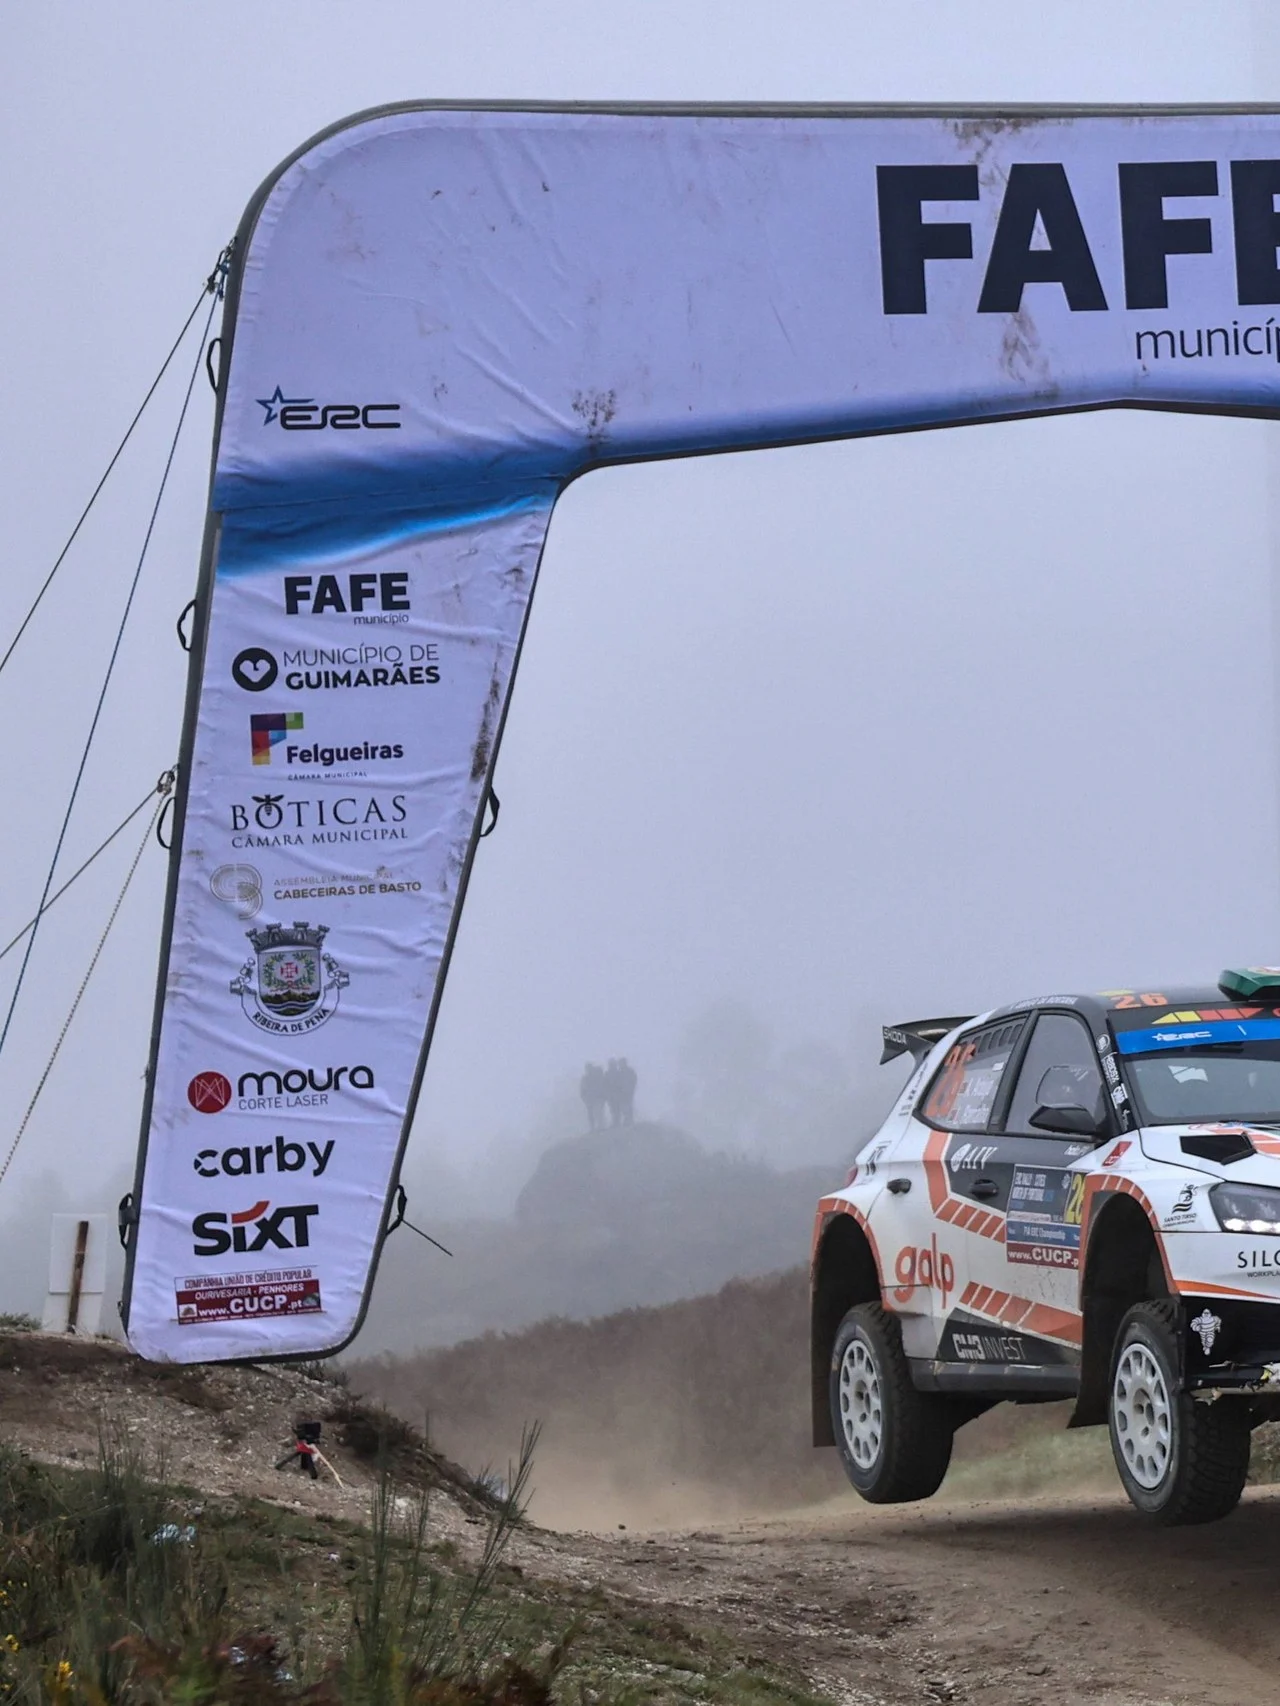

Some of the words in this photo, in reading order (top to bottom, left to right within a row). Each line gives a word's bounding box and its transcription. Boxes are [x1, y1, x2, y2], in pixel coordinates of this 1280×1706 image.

[280, 404, 401, 430] ERC
[284, 572, 411, 615] FAFE
[353, 612, 410, 626] município
[284, 643, 402, 667] MUNICÍPIO
[410, 643, 440, 661] DE
[285, 663, 441, 690] GUIMARÃES
[286, 741, 404, 767] Felgueiras
[324, 771, 368, 779] MUNICIPAL
[231, 795, 407, 831] BOTICAS
[231, 832, 304, 849] CÂMARA
[312, 828, 409, 845] MUNICIPAL
[273, 885, 356, 900] CABECEIRAS
[359, 883, 376, 894] DE
[379, 881, 422, 893] BASTO
[1110, 992, 1169, 1009] 26
[252, 1011, 289, 1033] RIBEIRA
[291, 1023, 304, 1033] DE
[304, 1009, 330, 1029] PENA
[238, 1065, 375, 1097] moura
[238, 1096, 283, 1110] CORTE
[286, 1094, 329, 1108] LASER
[193, 1136, 336, 1177] carby
[192, 1200, 320, 1256] SIXT
[1008, 1247, 1079, 1268] www.CUCP.p
[184, 1277, 224, 1289] COMPANHIA
[245, 1274, 254, 1284] DE
[282, 1269, 312, 1281] POPULAR
[892, 1232, 955, 1309] galp
[194, 1287, 252, 1301] OURIVESARIA
[258, 1282, 305, 1294] PENHORES
[198, 1294, 303, 1317] www.CUCP.pt
